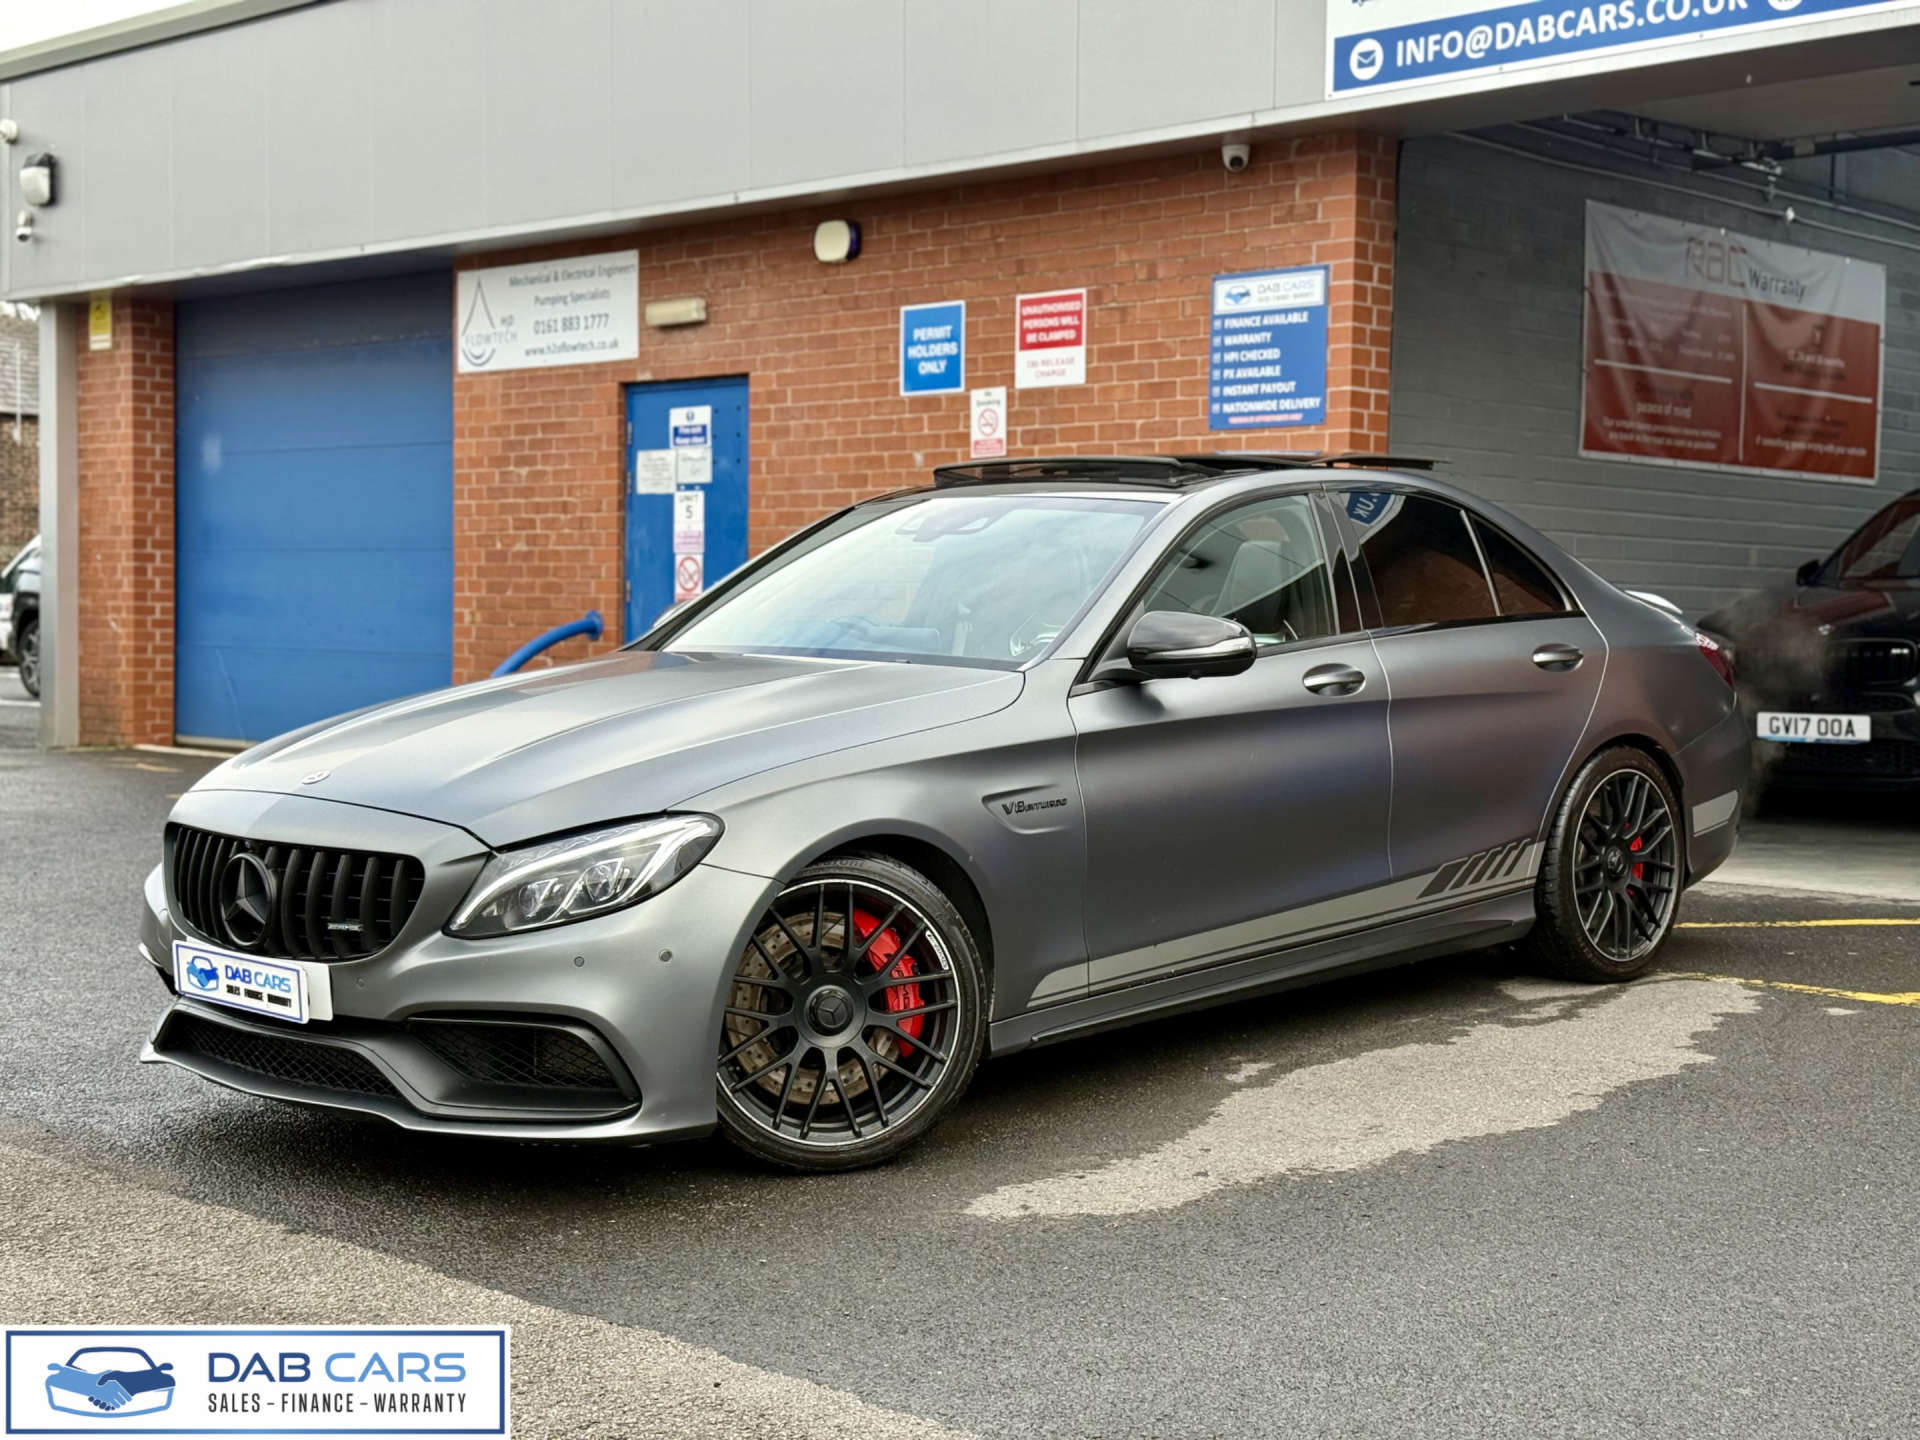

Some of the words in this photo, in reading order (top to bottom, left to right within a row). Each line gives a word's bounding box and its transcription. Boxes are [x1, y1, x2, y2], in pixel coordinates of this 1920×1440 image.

[1687, 236, 1747, 288] RAC
[1748, 267, 1806, 304] Warranty
[534, 295, 569, 307] Pumping
[583, 312, 609, 331] 1777
[1224, 316, 1261, 329] FINANCE
[1263, 311, 1309, 326] AVAILABLE
[913, 325, 952, 341] PERMIT
[1224, 332, 1272, 346] WARRANTY
[907, 342, 958, 358] HOLDERS
[1240, 348, 1281, 361] CHECKED
[918, 359, 948, 374] ONLY
[1236, 365, 1281, 378] AVAILABLE
[1223, 384, 1259, 397] INSTANT
[1260, 381, 1296, 394] PAYOUT
[1222, 400, 1278, 413] NATIONWIDE
[1279, 397, 1322, 410] DELIVERY
[1769, 716, 1811, 736] GV17
[225, 964, 252, 984] DAB
[254, 971, 292, 993] CARS
